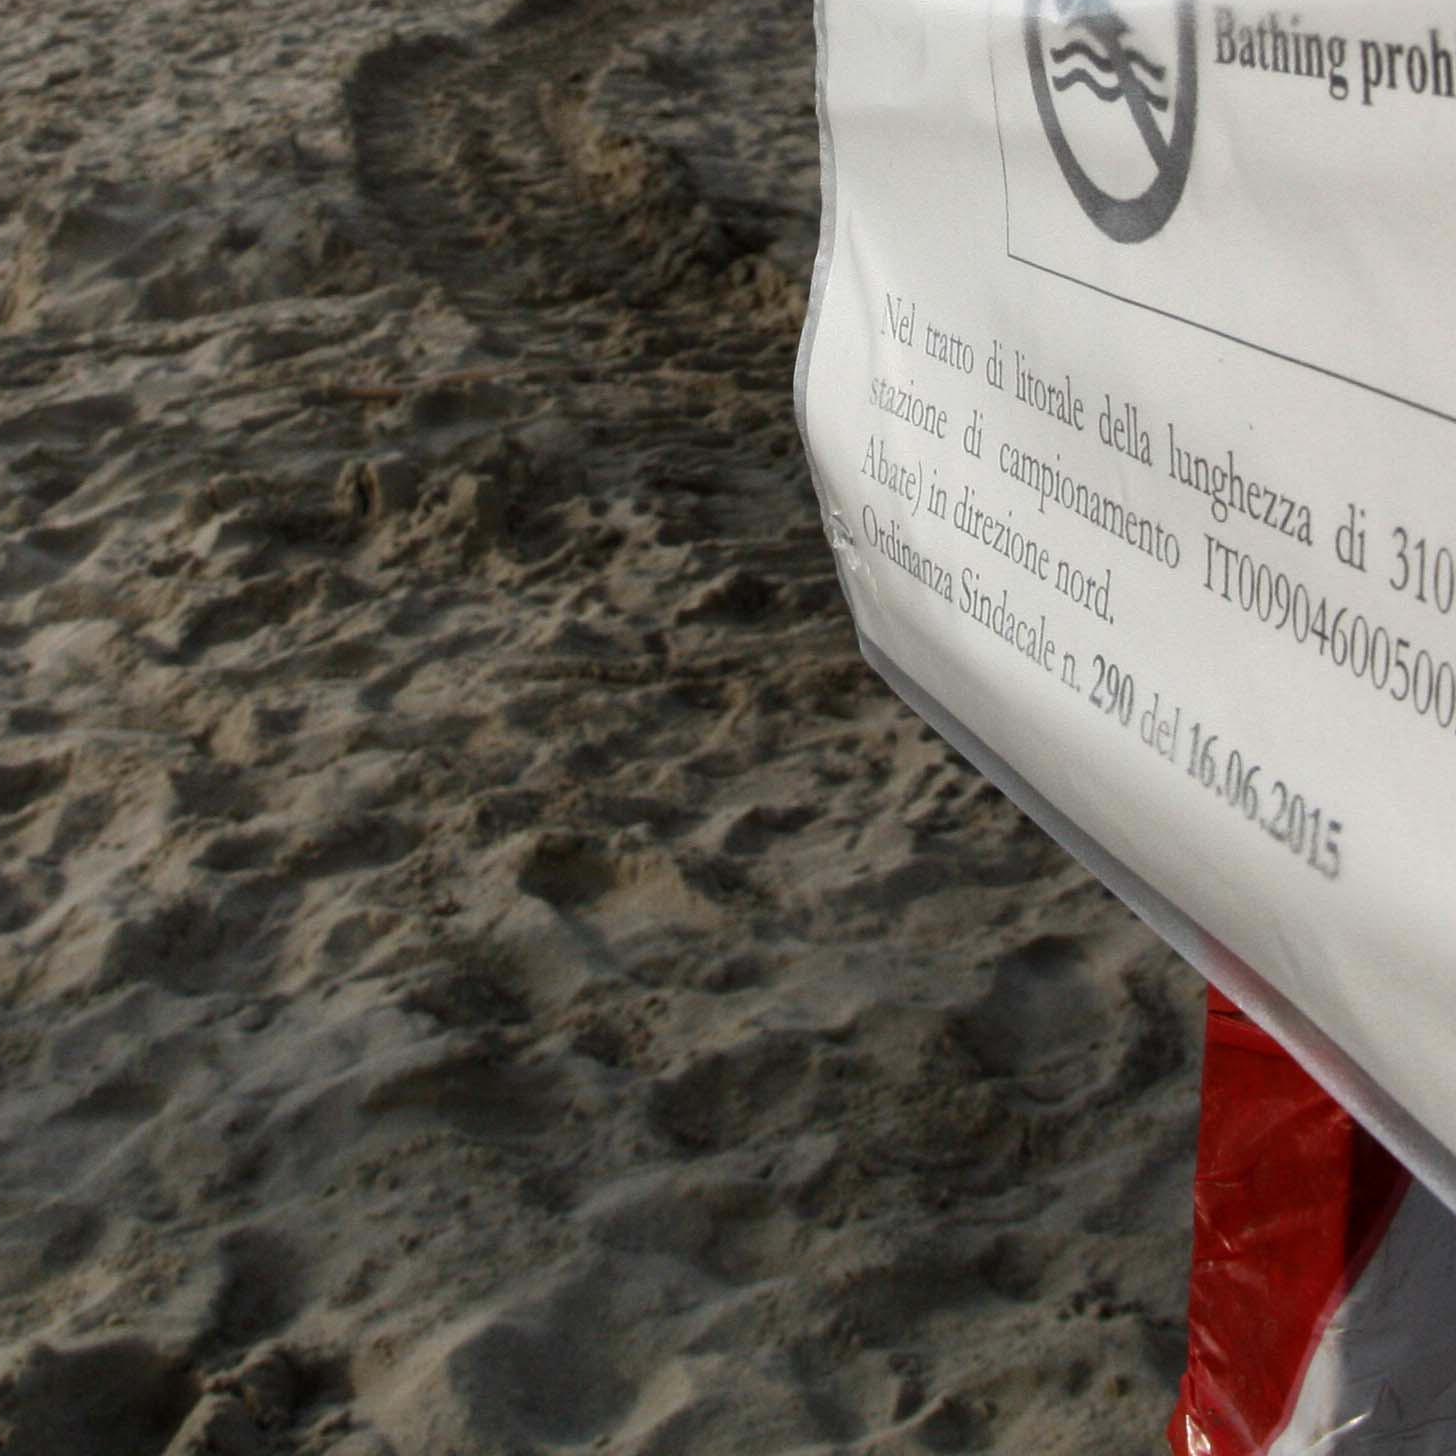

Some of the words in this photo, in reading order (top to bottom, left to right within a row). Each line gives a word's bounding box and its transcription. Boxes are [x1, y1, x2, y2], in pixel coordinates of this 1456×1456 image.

[1213, 6, 1347, 101] Bathing
[861, 434, 923, 517] Abate)
[927, 468, 948, 520] in
[953, 485, 1049, 581] direzione
[1055, 559, 1115, 625] nord.
[869, 378, 948, 439] stazione
[963, 409, 984, 459] di
[999, 443, 1180, 569] campionamento
[880, 292, 916, 347] Nel
[925, 321, 975, 374] tratto
[986, 339, 1004, 391] di
[1015, 350, 1085, 432] litorale
[1099, 394, 1153, 467] della
[1167, 422, 1313, 546] lunghezza
[1335, 503, 1368, 573] di
[1389, 526, 1455, 615] 310
[862, 504, 954, 604] Ordinanza
[959, 567, 1056, 672] Sindacale
[1060, 651, 1081, 693] n.
[1088, 654, 1135, 727] 290
[1139, 693, 1181, 763] del
[1186, 722, 1342, 880] 16.06.2015
